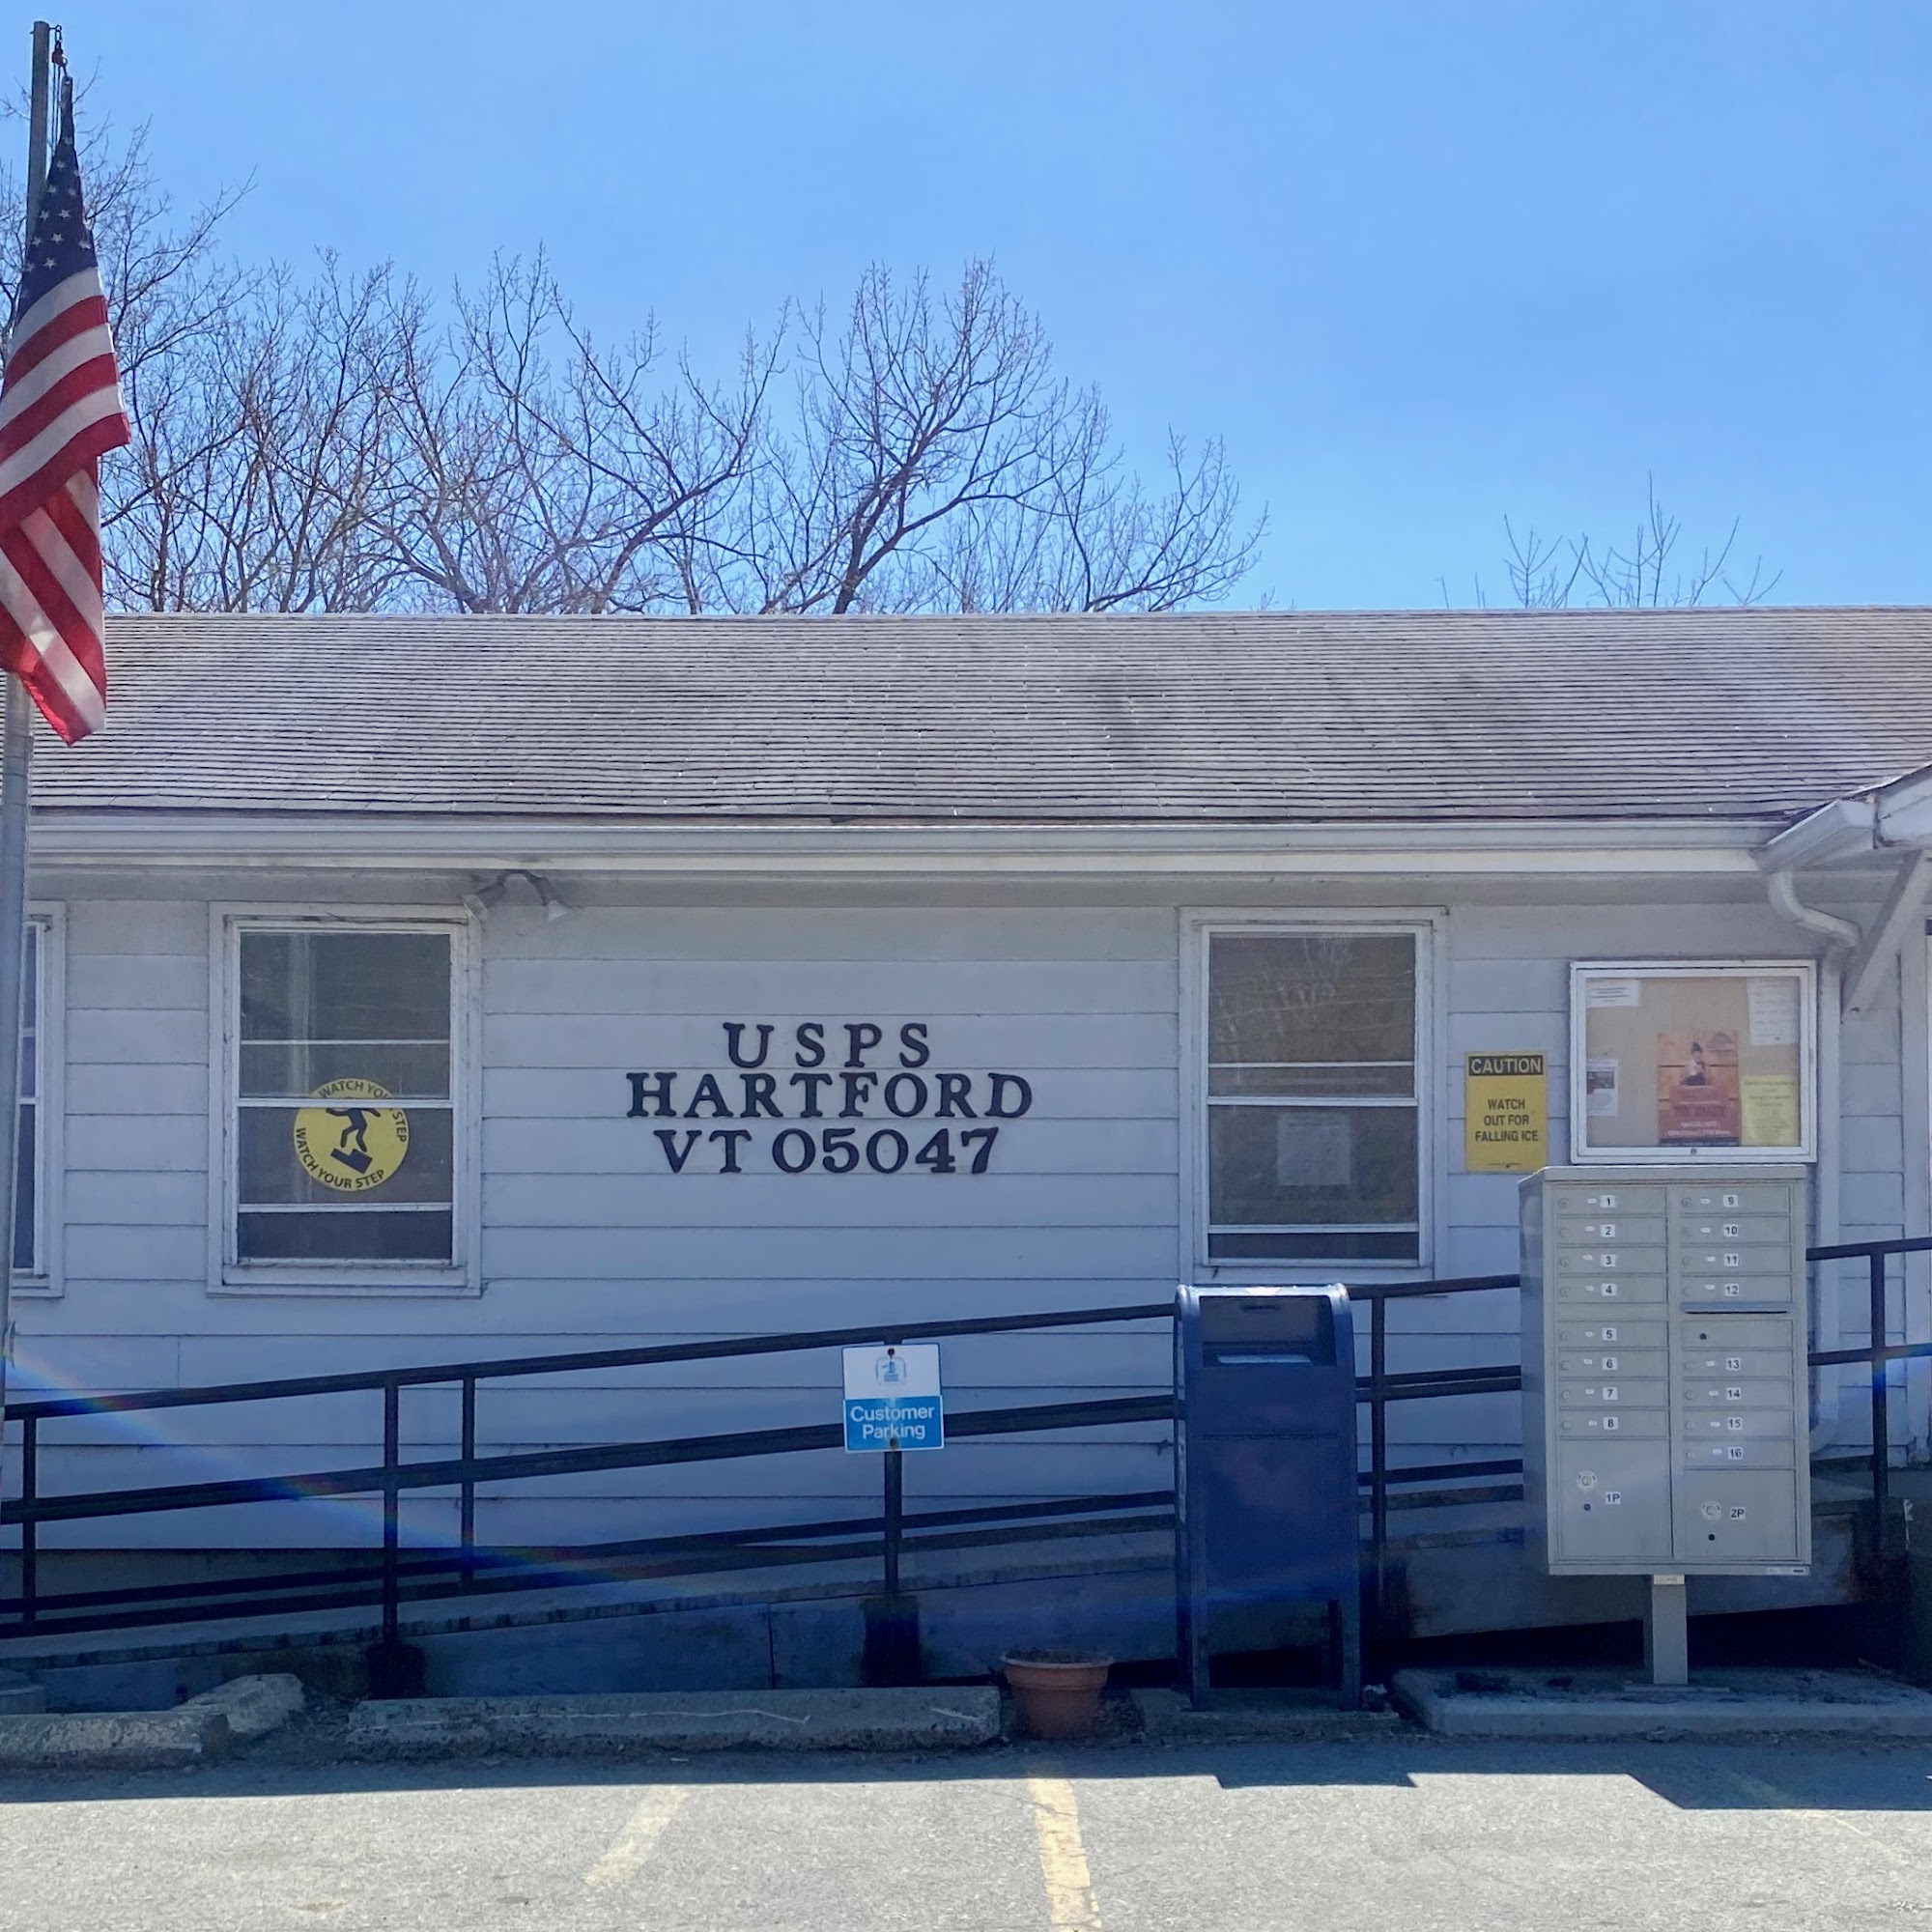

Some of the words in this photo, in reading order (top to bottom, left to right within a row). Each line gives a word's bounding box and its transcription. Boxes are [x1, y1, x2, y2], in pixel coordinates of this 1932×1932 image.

[723, 1022, 930, 1068] USPS
[1470, 1058, 1542, 1074] CAUTION
[626, 1072, 1033, 1119] HARTFORD
[1488, 1098, 1525, 1110] WATCH
[318, 1080, 364, 1098] WATCH
[392, 1111, 408, 1143] STEP
[1484, 1115, 1505, 1126] OUT
[1508, 1114, 1529, 1125] FOR
[1475, 1130, 1519, 1142] FALLING
[1521, 1130, 1539, 1142] ICE
[653, 1128, 753, 1174] VT
[772, 1126, 1000, 1174] 05047
[296, 1127, 319, 1172] WATCH
[318, 1168, 353, 1189] YOUR
[355, 1169, 384, 1189] STEP
[1727, 1196, 1734, 1206] 9
[1605, 1226, 1611, 1236] 2
[1725, 1226, 1738, 1235] 10
[1605, 1256, 1612, 1265] 3
[1726, 1255, 1738, 1264] 11
[1605, 1285, 1612, 1294] 4
[1725, 1285, 1739, 1294] 12
[1605, 1329, 1613, 1339] 5
[1605, 1359, 1613, 1369] 6
[1727, 1359, 1740, 1369] 13
[1607, 1388, 1613, 1398] 7
[1728, 1389, 1740, 1398] 14
[850, 1406, 935, 1422] Customer
[1607, 1418, 1614, 1428] 8
[1728, 1419, 1741, 1428] 15
[862, 1423, 926, 1440] Parking
[1729, 1448, 1742, 1458] 16
[1606, 1493, 1620, 1503] 1P
[1730, 1508, 1745, 1518] 2P
